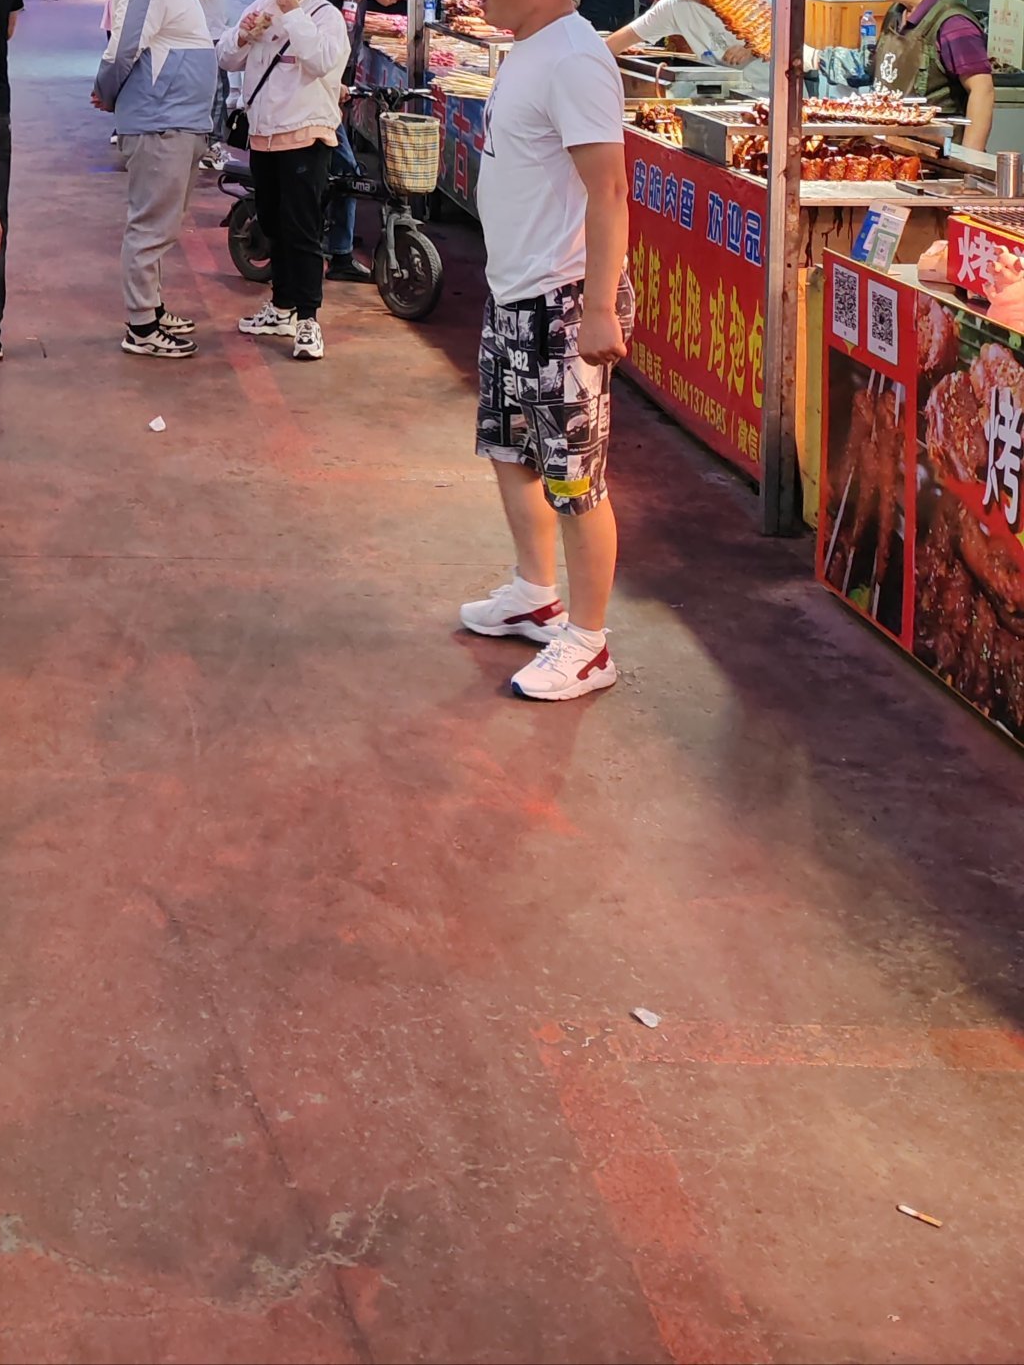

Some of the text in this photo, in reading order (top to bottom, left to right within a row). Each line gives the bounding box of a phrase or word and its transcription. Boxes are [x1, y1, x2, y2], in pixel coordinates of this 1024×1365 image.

[633, 158, 766, 267] 皮脆肉香 欢迎品
[667, 253, 702, 362] 鸡腿
[669, 368, 727, 435] 15041374585
[983, 385, 1022, 524] 烤
